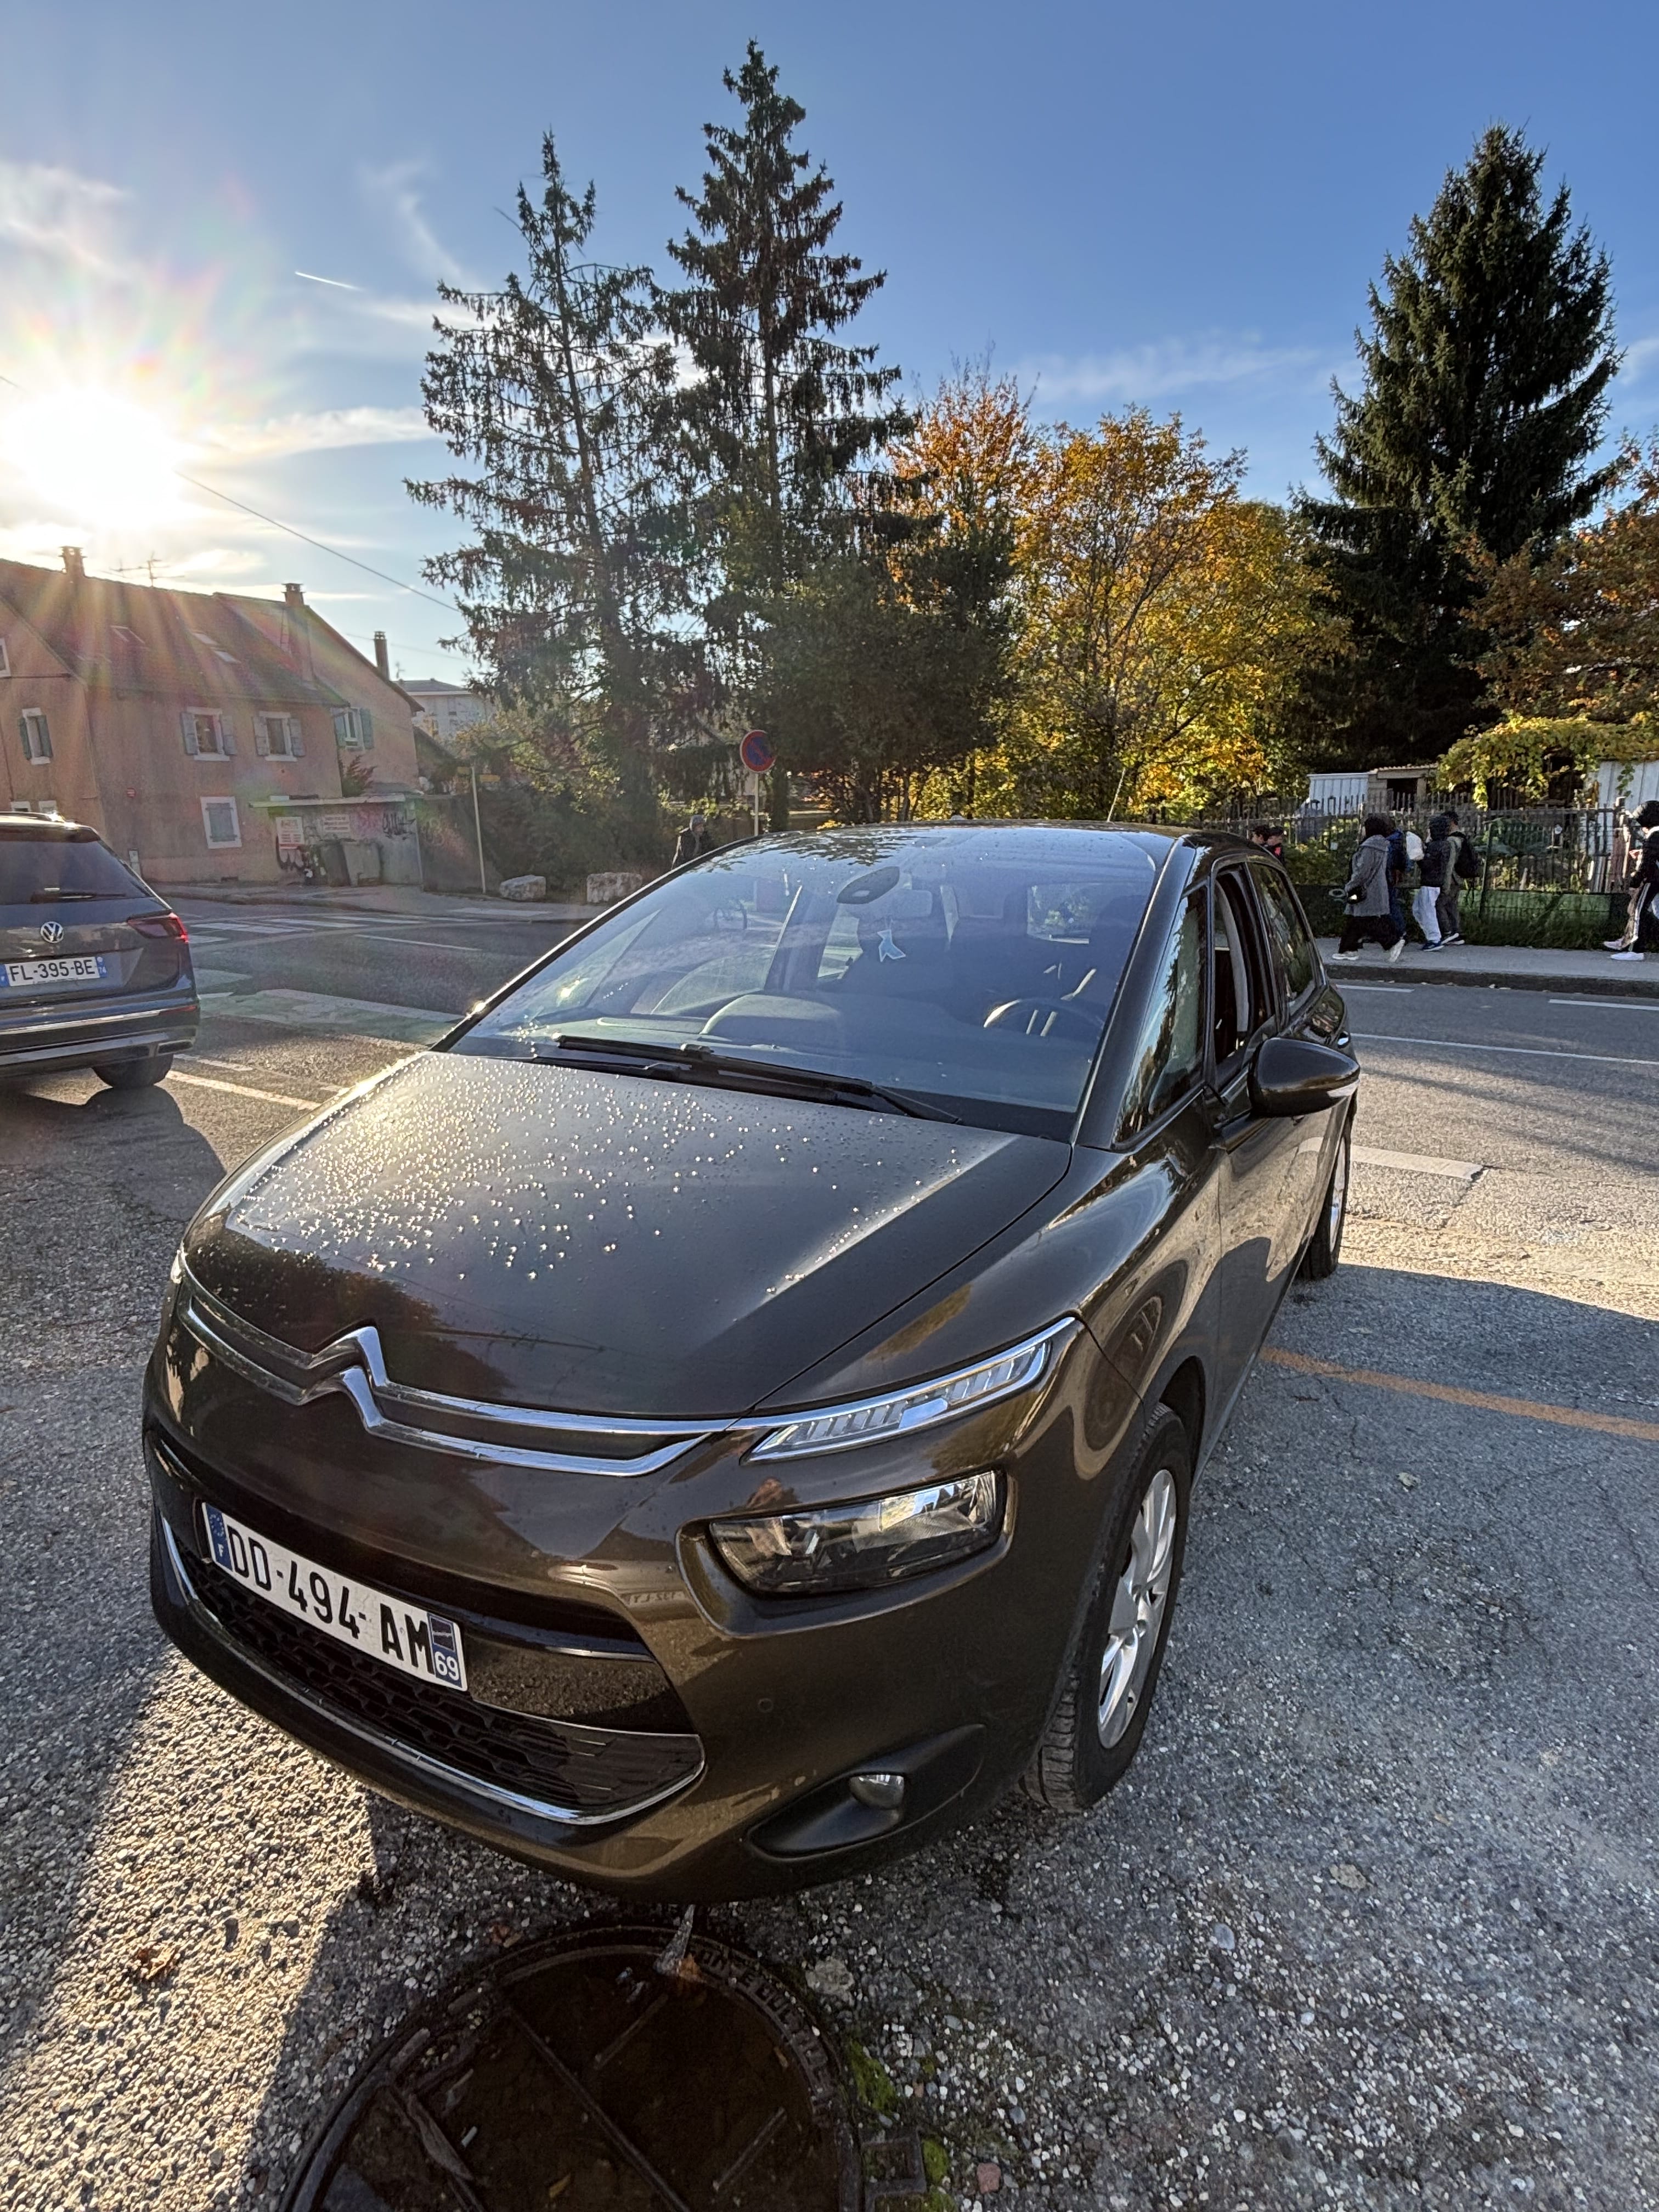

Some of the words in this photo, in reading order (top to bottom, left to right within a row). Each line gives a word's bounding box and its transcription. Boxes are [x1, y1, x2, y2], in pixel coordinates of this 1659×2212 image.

[9, 960, 95, 981] FL-395-BE
[218, 1543, 224, 1558] F
[227, 1525, 435, 1675] DD-494-AM
[435, 1651, 460, 1681] 69
